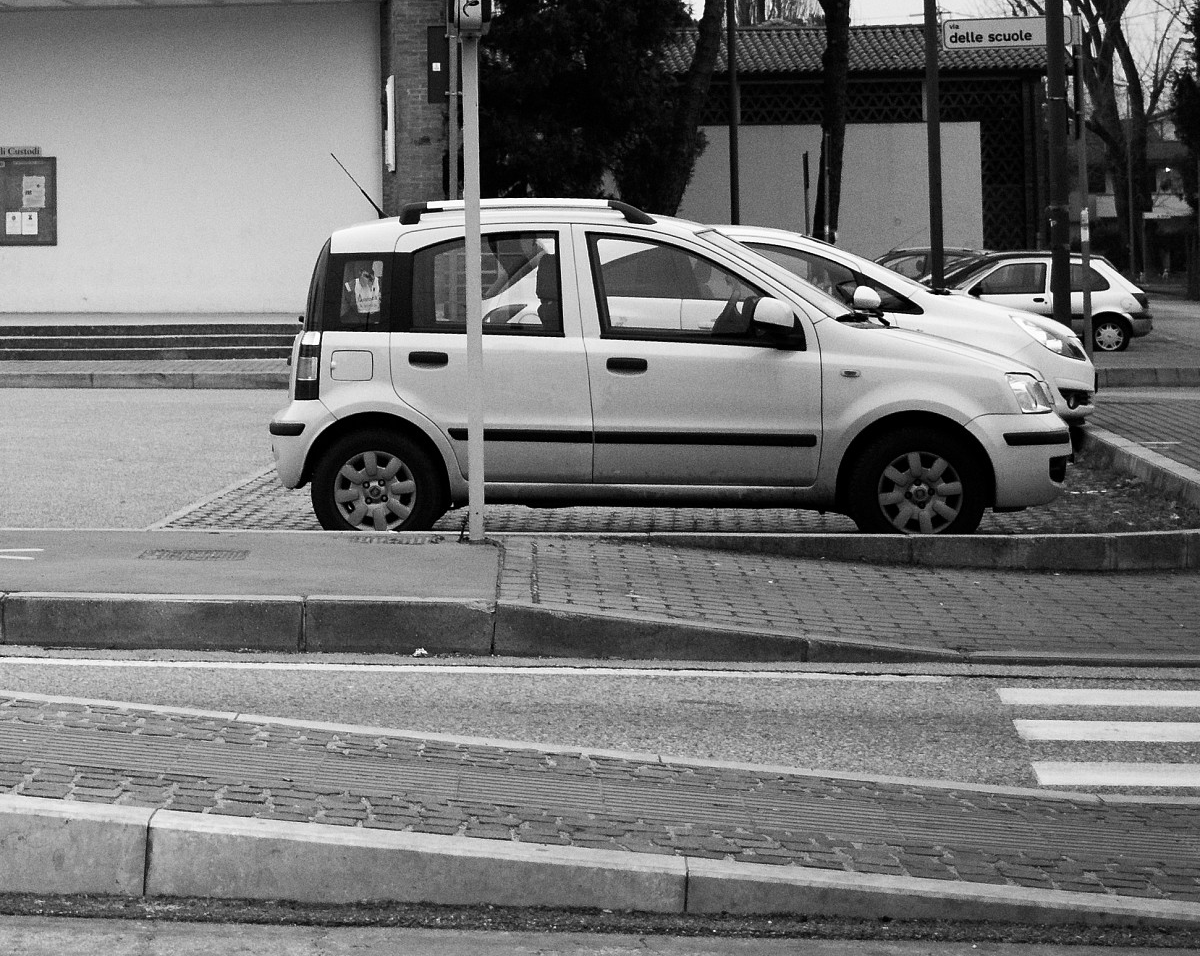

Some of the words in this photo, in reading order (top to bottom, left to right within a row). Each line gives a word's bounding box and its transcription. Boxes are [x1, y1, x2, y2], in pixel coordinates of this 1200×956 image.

[949, 32, 984, 43] delle
[988, 29, 1033, 42] scuole
[7, 146, 40, 156] Custodi
